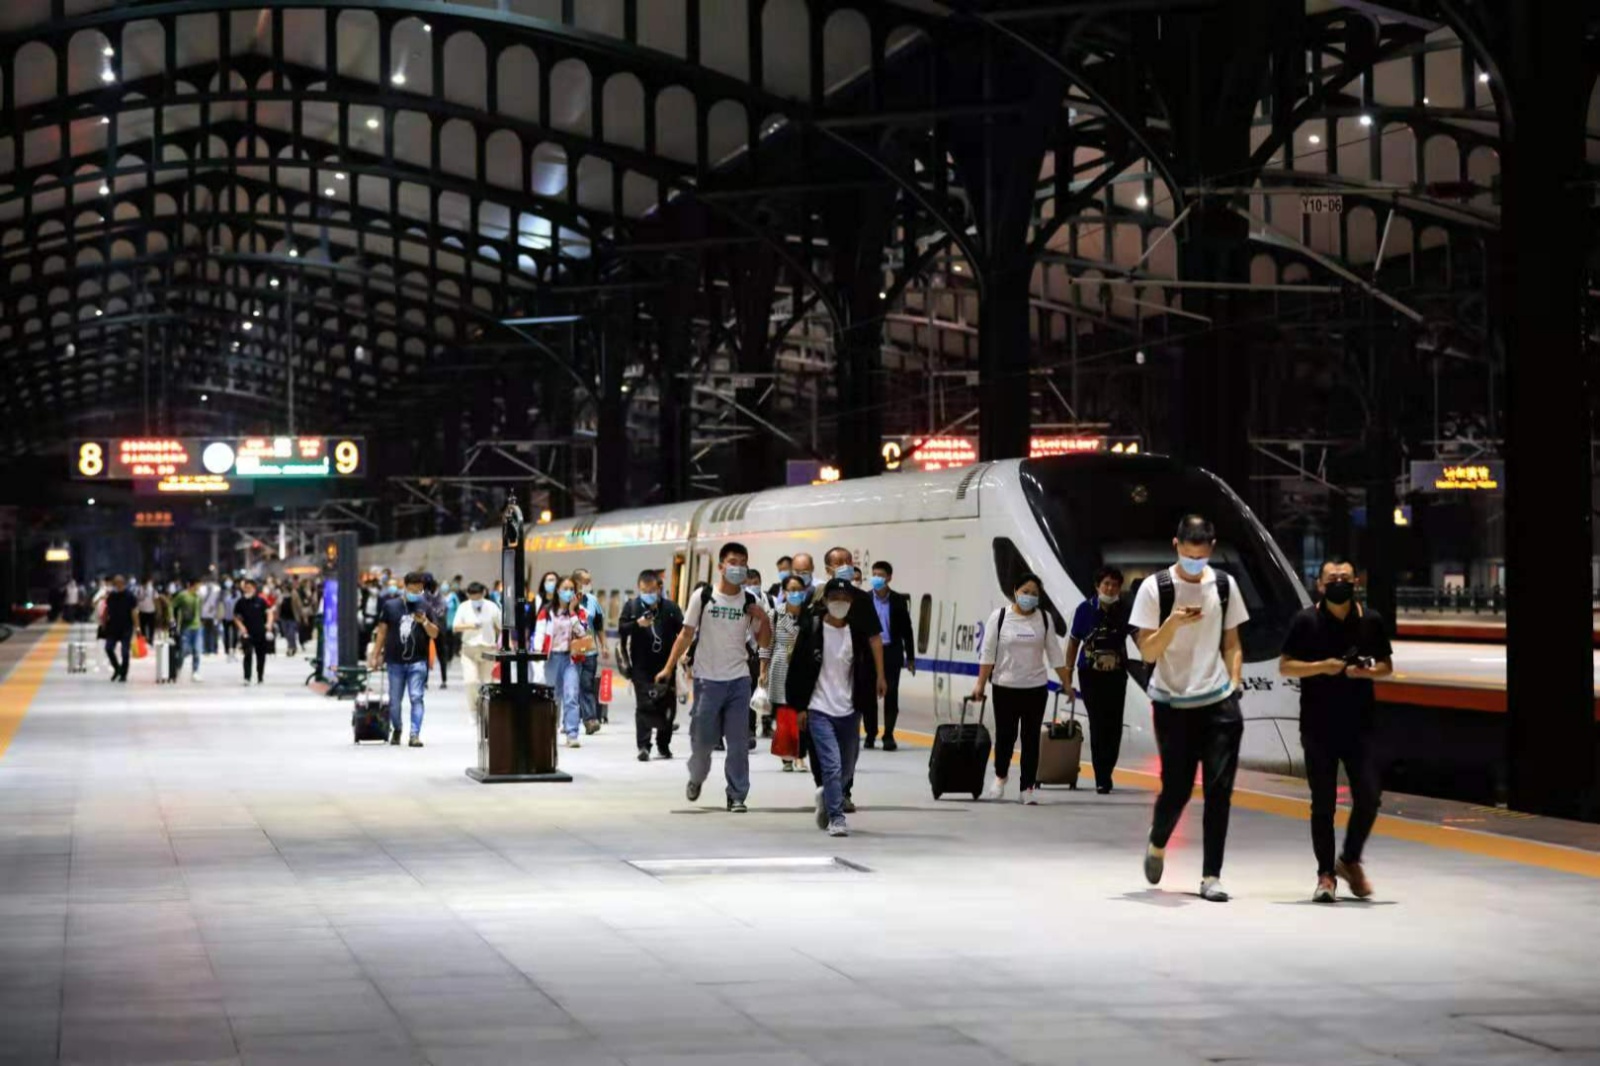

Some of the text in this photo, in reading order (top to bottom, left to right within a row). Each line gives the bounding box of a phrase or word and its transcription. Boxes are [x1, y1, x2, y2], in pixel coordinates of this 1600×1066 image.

[1302, 198, 1342, 212] Y10-06
[79, 441, 103, 476] 8
[335, 441, 359, 475] 9
[956, 624, 975, 652] CRH
